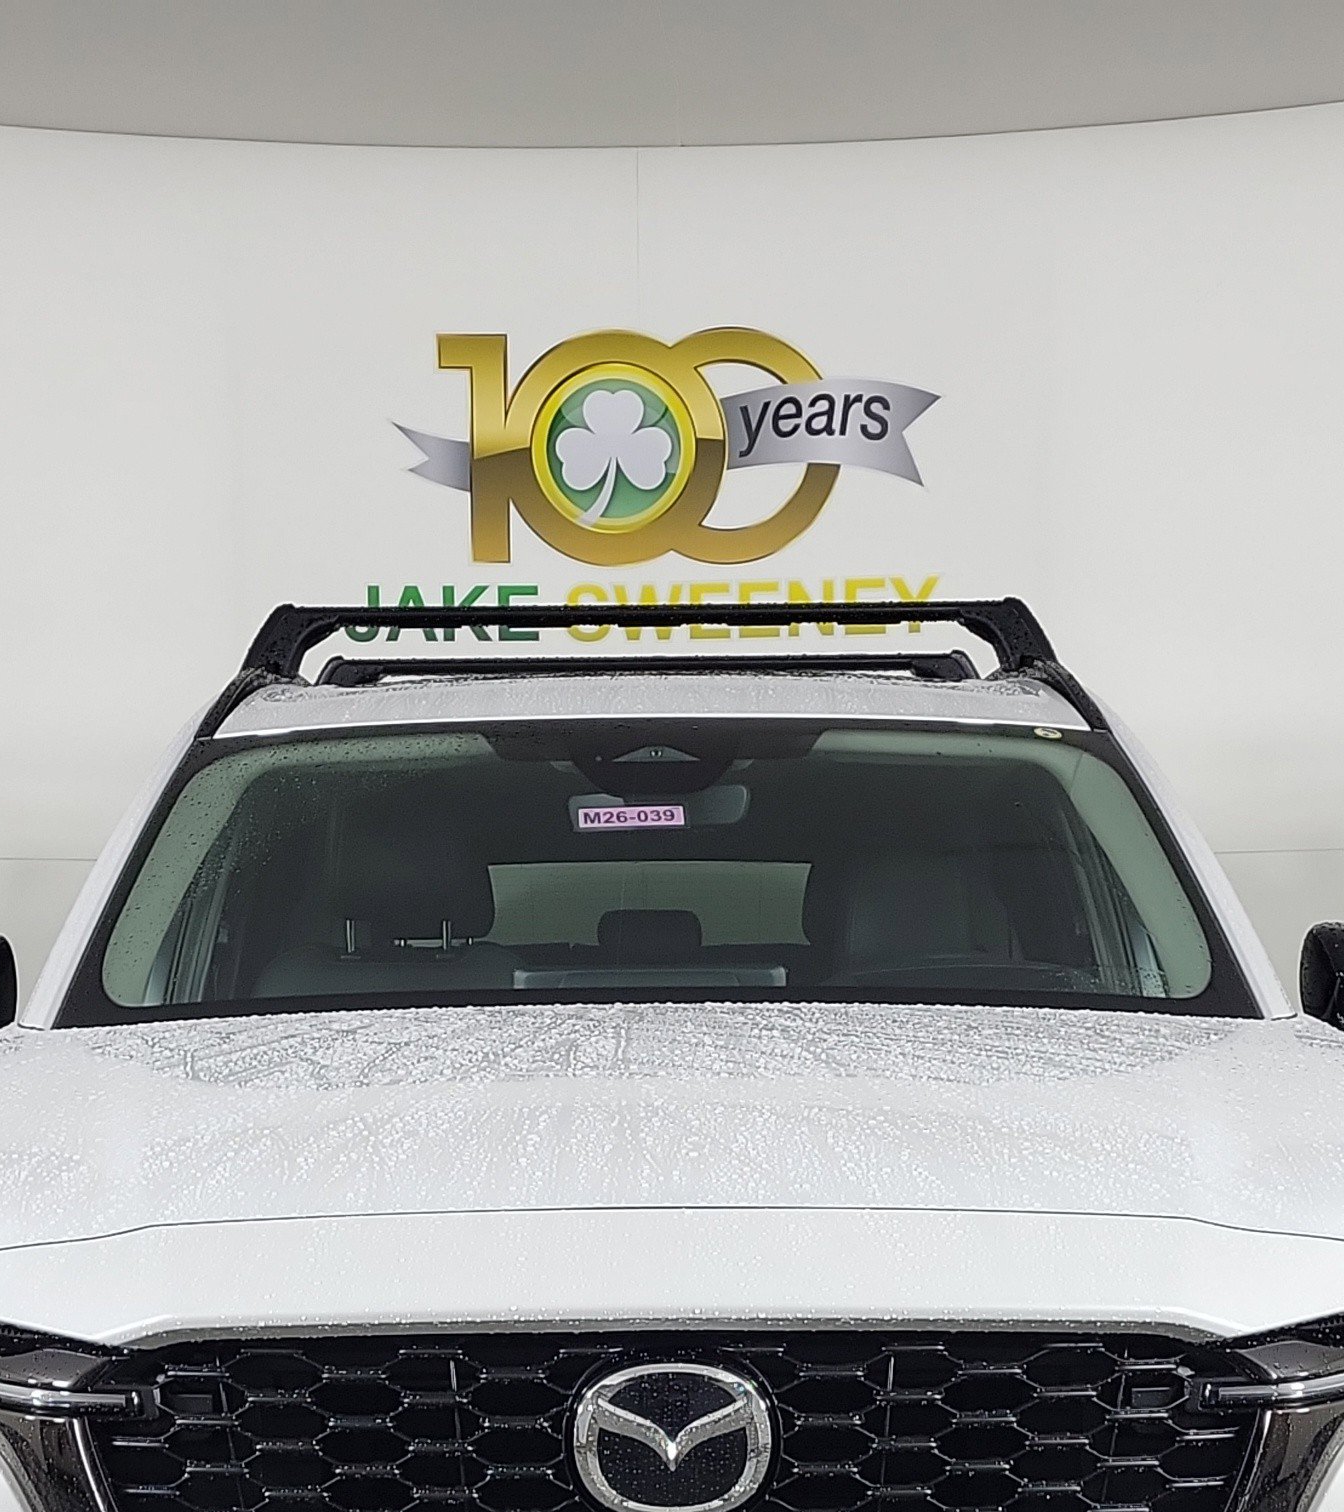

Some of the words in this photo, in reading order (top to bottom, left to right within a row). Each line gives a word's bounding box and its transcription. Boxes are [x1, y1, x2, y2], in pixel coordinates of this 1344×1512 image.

[435, 325, 840, 566] 100
[737, 392, 891, 459] years
[583, 809, 675, 824] M26-039
